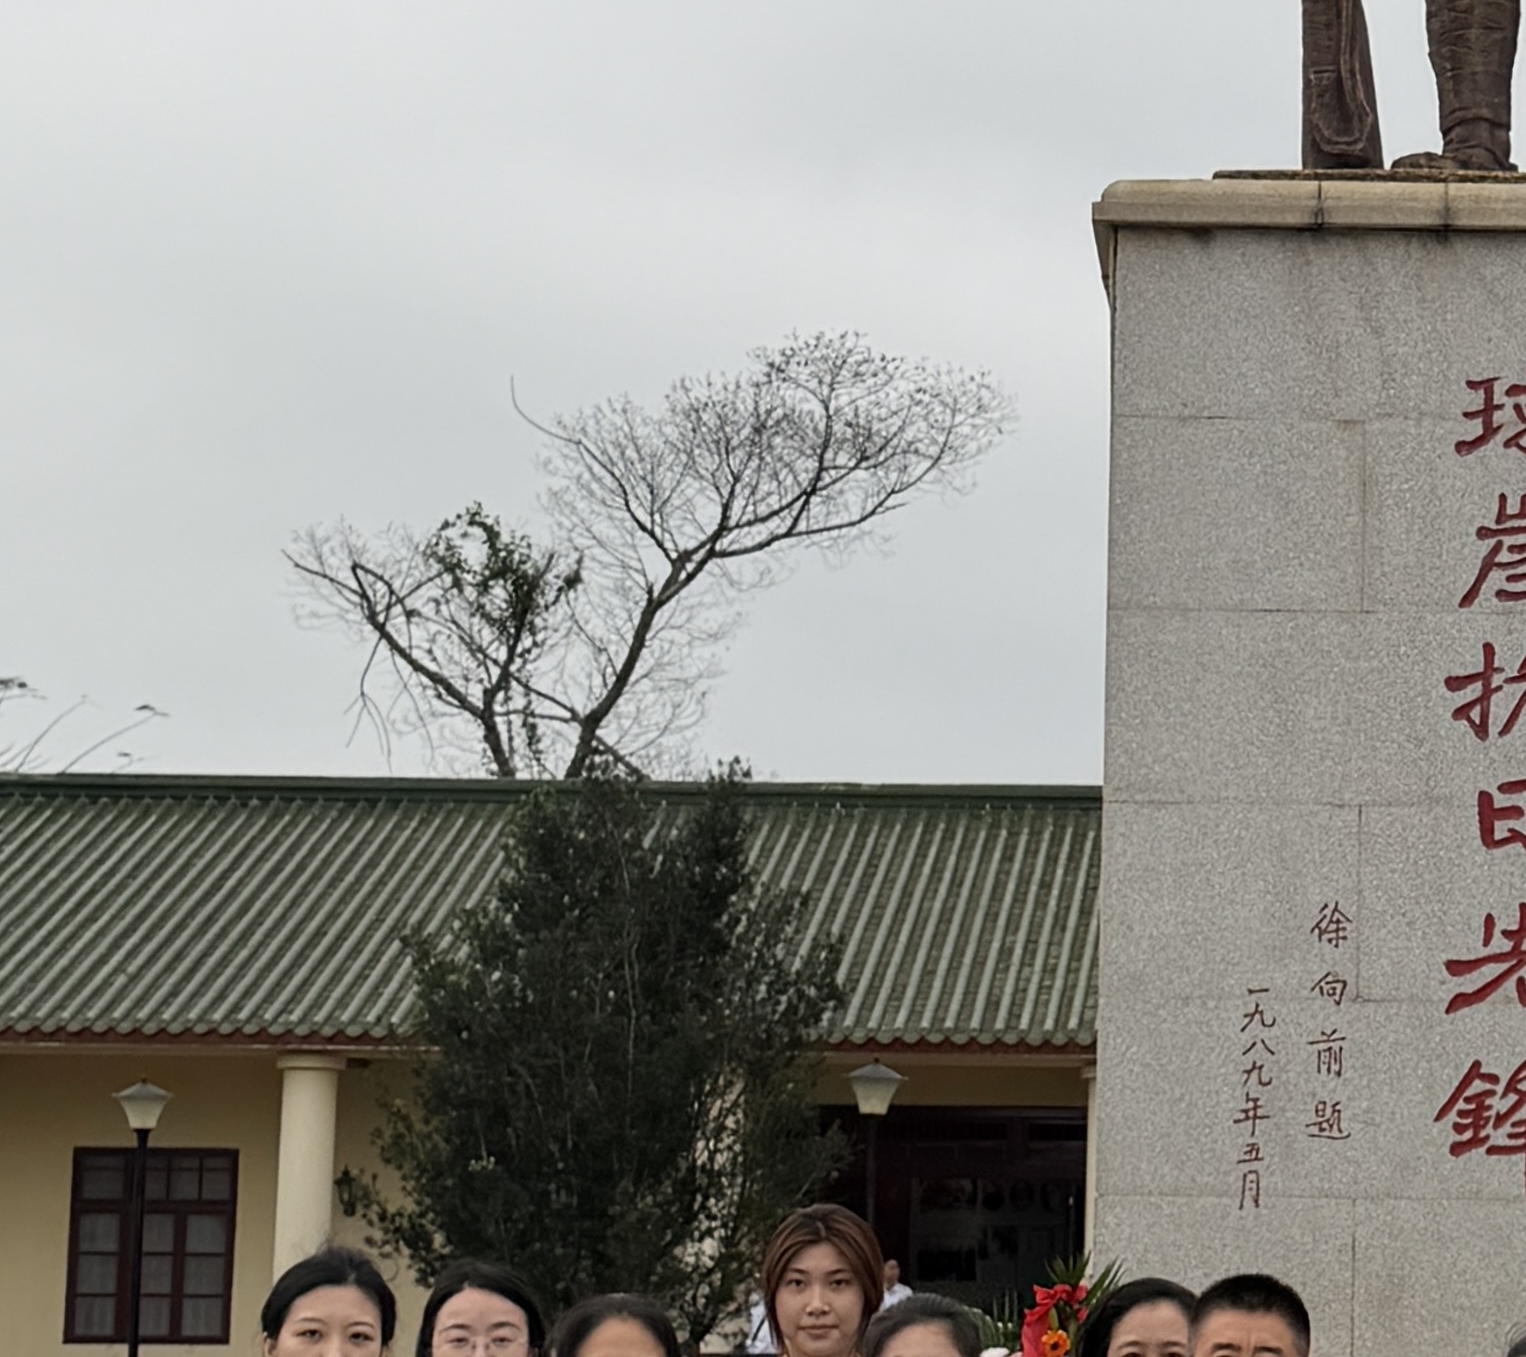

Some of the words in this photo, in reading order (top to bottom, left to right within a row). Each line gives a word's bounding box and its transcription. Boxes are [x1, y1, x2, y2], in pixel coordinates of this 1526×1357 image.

[1233, 986, 1277, 1211] 一九八九年五月
